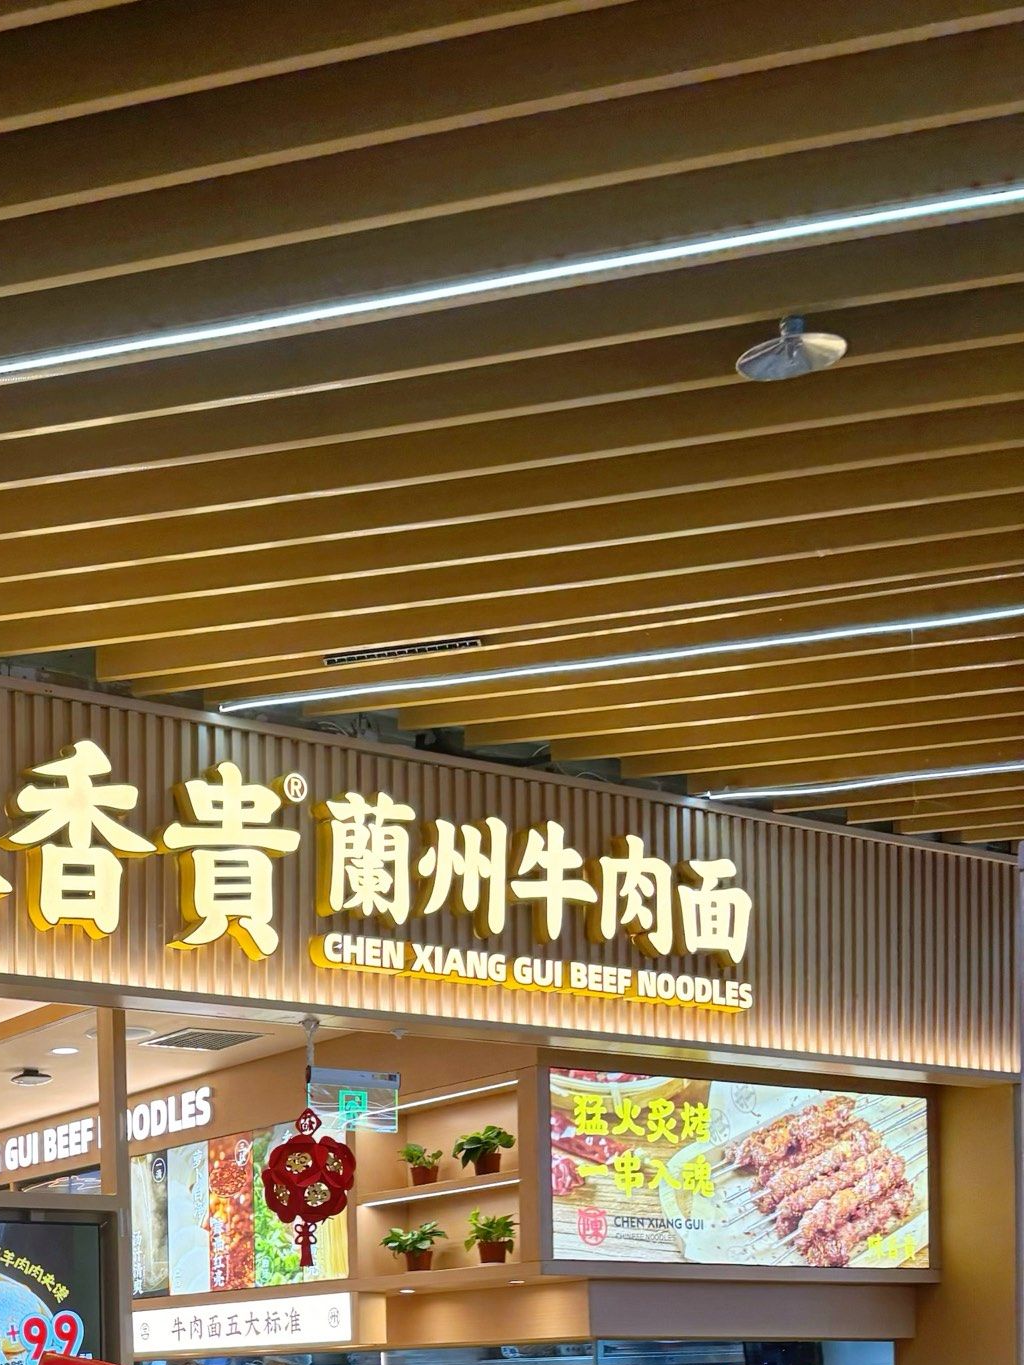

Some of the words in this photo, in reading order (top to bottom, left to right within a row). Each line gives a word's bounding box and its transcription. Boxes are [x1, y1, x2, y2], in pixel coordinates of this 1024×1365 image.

[326, 792, 753, 965] 蘭州牛肉面
[324, 933, 405, 969] CHEN
[411, 944, 507, 982] XIANG
[513, 956, 563, 988] GUI
[569, 962, 632, 994] BEEF
[637, 970, 753, 1009] NOODLES
[5, 1131, 39, 1172] GUI
[43, 1117, 93, 1163] BEEF
[98, 1087, 211, 1149] ODLES
[574, 1094, 712, 1143] 猛火炙烤
[578, 1149, 715, 1198] 一串入魂
[614, 1216, 643, 1228] CHEN
[647, 1218, 682, 1230] XIANG
[685, 1219, 704, 1230] GUI
[171, 1307, 302, 1341] 牛肉面五大标准
